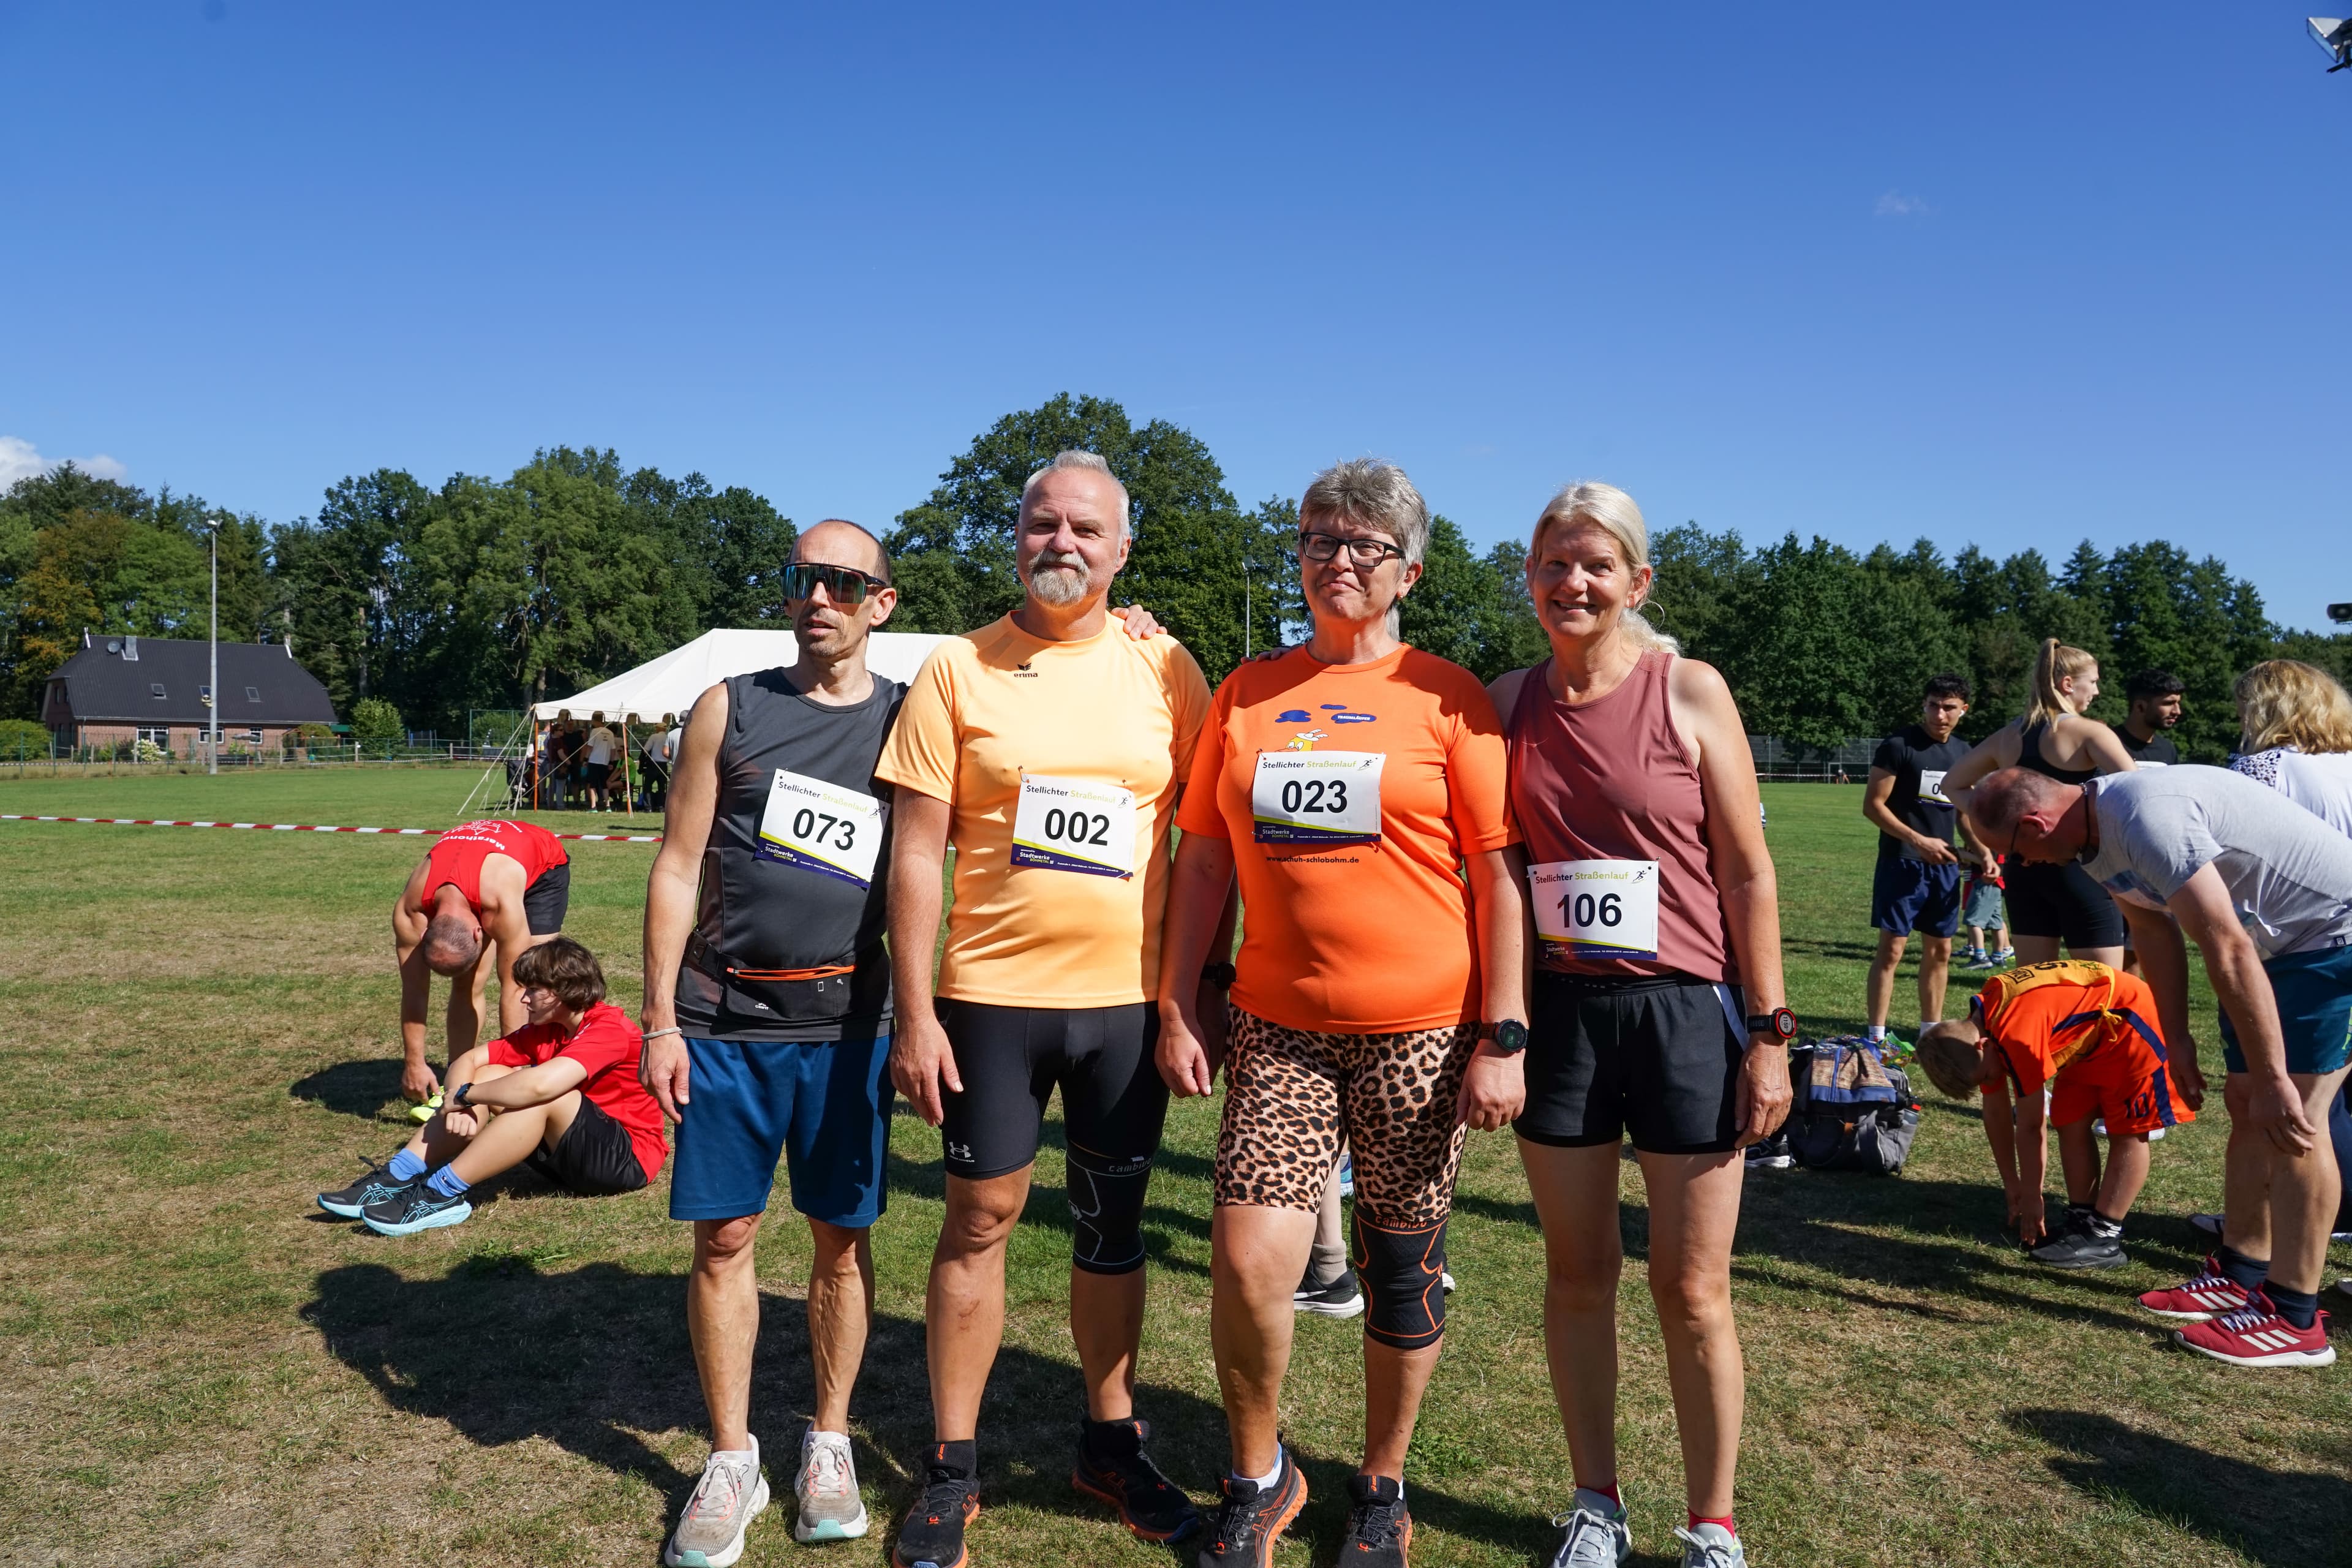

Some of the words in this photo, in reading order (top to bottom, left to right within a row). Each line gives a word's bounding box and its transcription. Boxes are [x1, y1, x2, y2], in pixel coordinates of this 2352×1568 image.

[1306, 760, 1357, 768] Straßenlauf
[778, 782, 821, 799] Stellichter
[822, 793, 868, 813] Straßenlauf
[1026, 785, 1069, 797] Stellichter
[1070, 789, 1117, 804] Straßenlauf
[1282, 780, 1348, 813] 023
[793, 808, 856, 851] 073
[1045, 809, 1110, 846] 002
[764, 846, 794, 858] Stadtwerke
[1536, 873, 1573, 884] Stellichter
[1575, 872, 1629, 880] Straßenlauf
[1557, 893, 1622, 929] 106
[2124, 1092, 2149, 1119] 10
